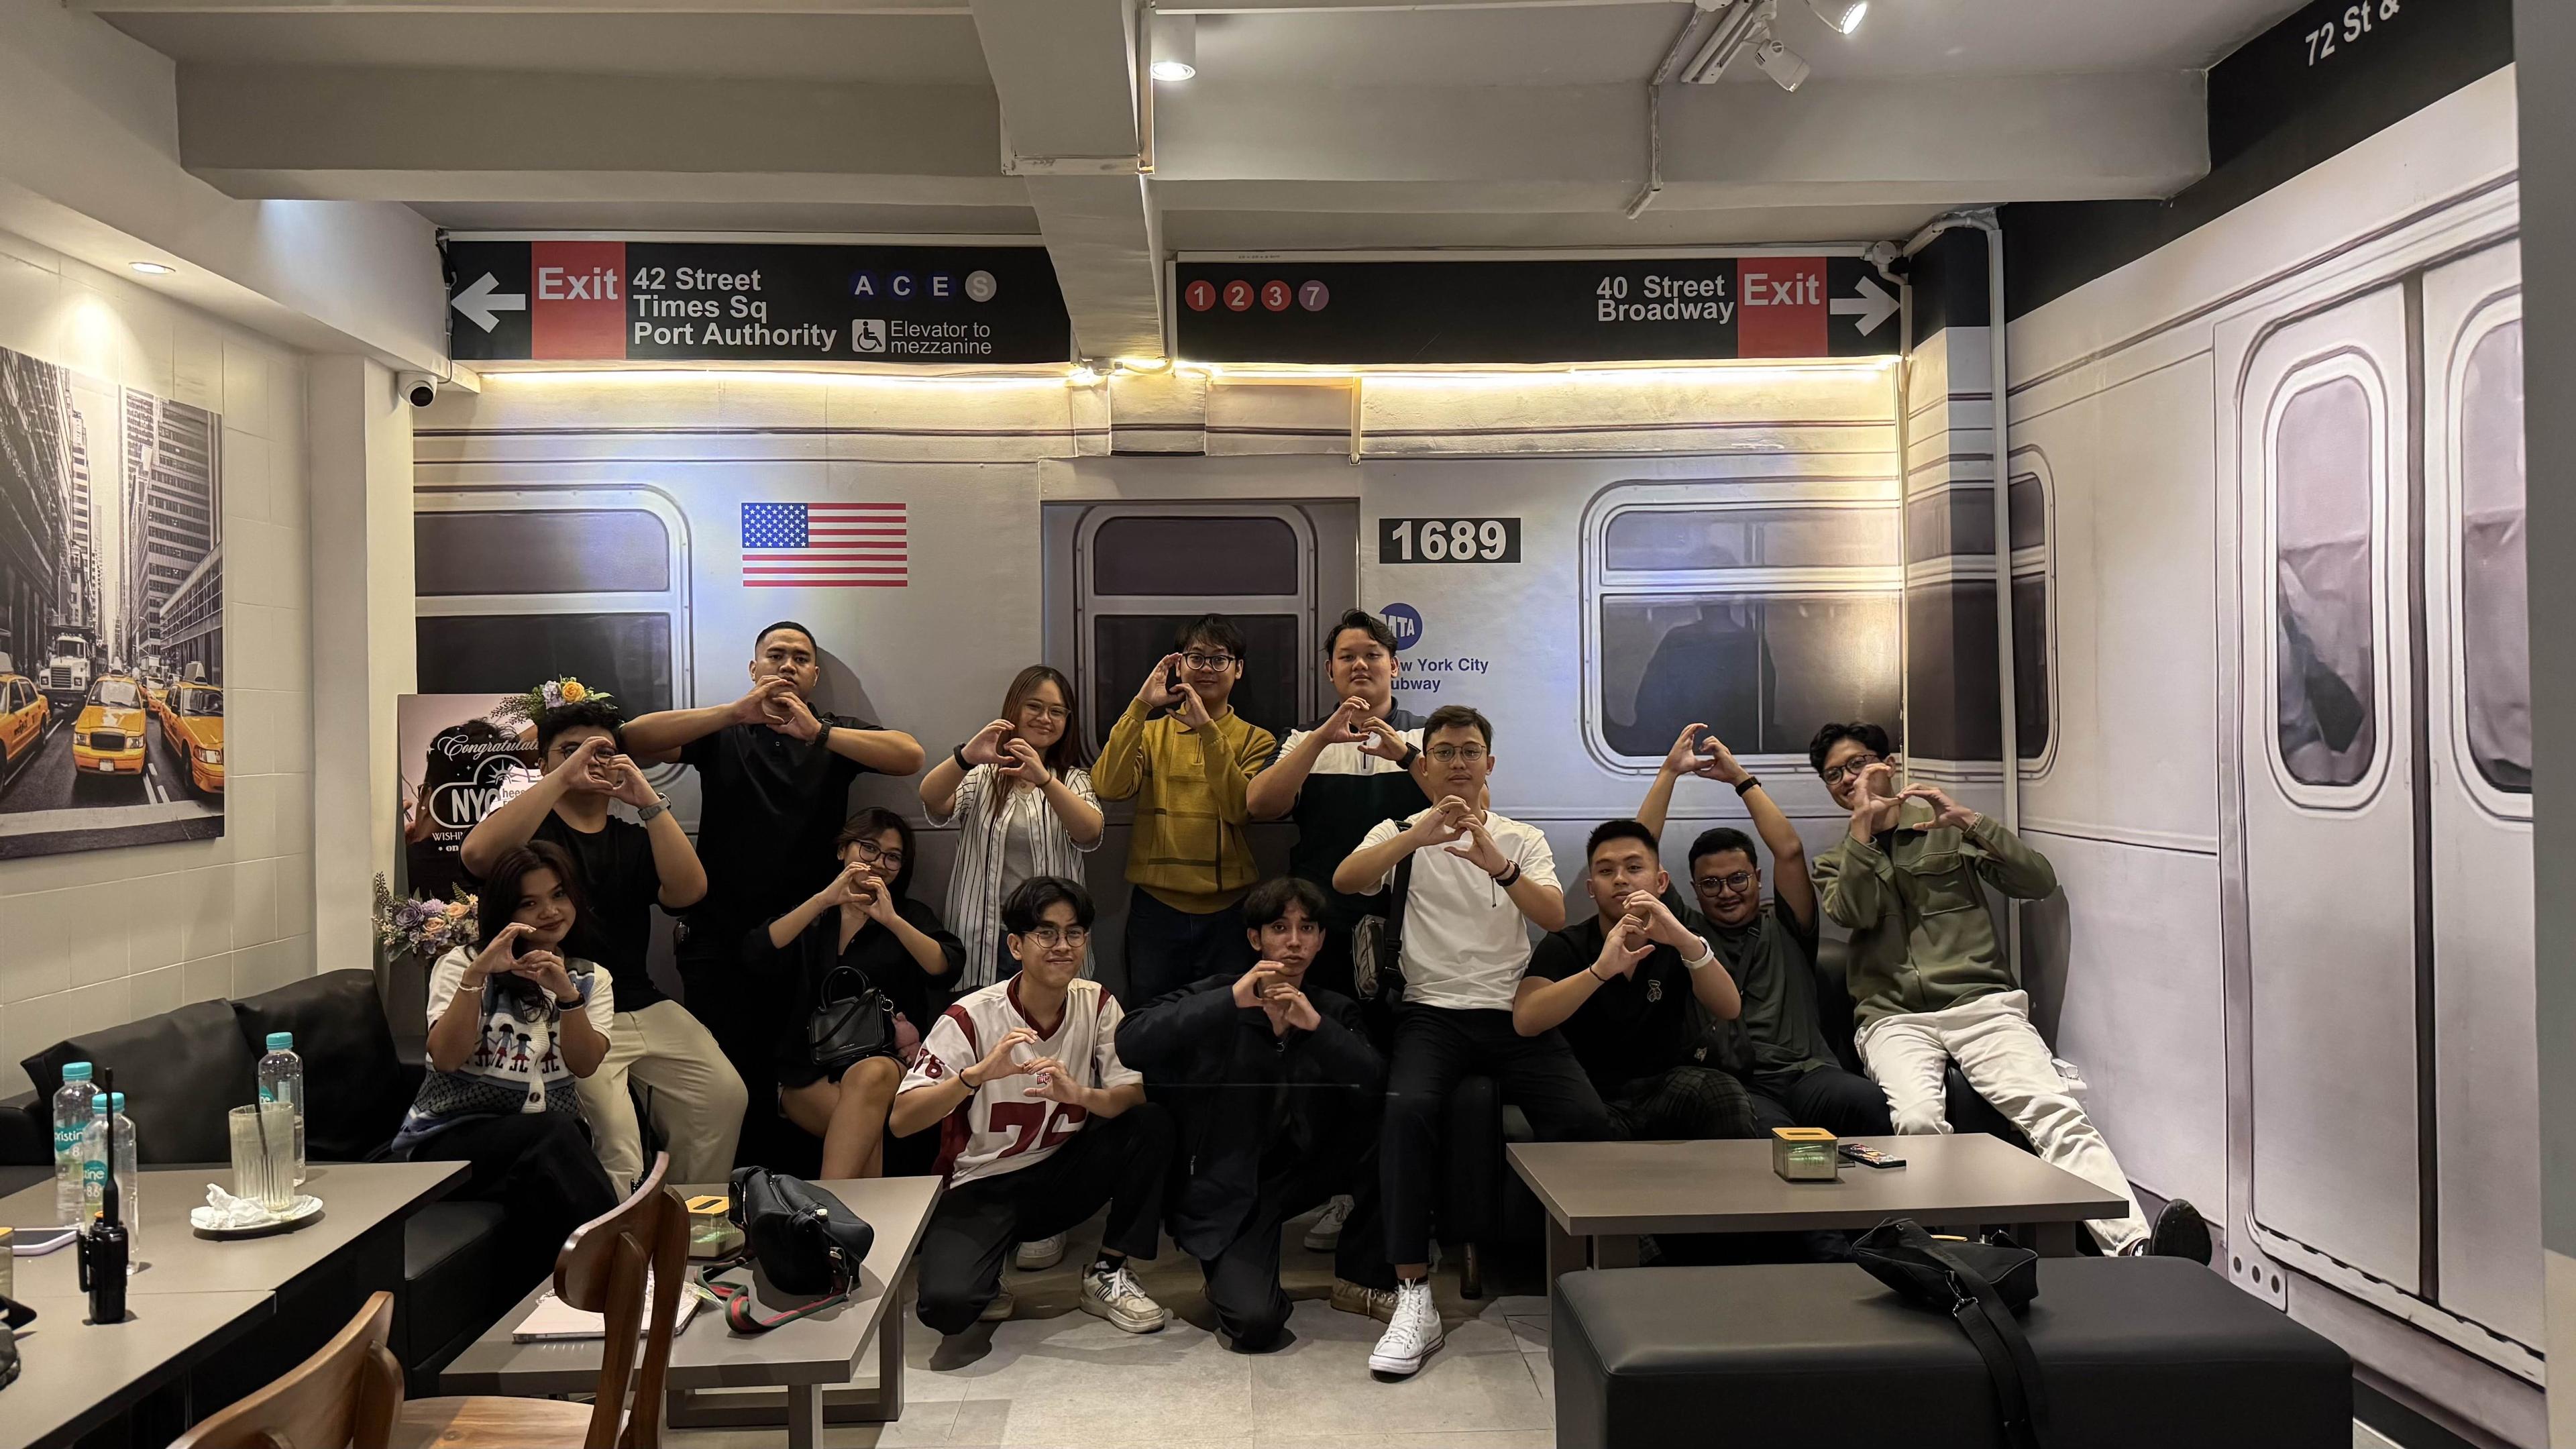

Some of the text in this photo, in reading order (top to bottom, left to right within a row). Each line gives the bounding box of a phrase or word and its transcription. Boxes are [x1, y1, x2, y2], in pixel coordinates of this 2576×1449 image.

[2306, 21, 2335, 66] 72
[2343, 0, 2371, 42] St
[539, 267, 618, 301] Exit
[633, 268, 761, 291] 42 Street
[855, 276, 989, 297] A C E S
[1596, 274, 1725, 299] 40 Street
[1744, 272, 1820, 306] Exit
[633, 294, 767, 323] Times Sq
[1193, 286, 1320, 307] 1 2 3 7
[1598, 299, 1735, 325] Broadway
[634, 322, 837, 352] Port Authority
[891, 320, 991, 337] Elevator to
[891, 337, 992, 354] mezzanine
[1392, 521, 1507, 560] 1689
[1417, 658, 1453, 672] York
[1458, 657, 1489, 674] City
[1391, 677, 1441, 693] ubway
[431, 831, 464, 841] WISHI
